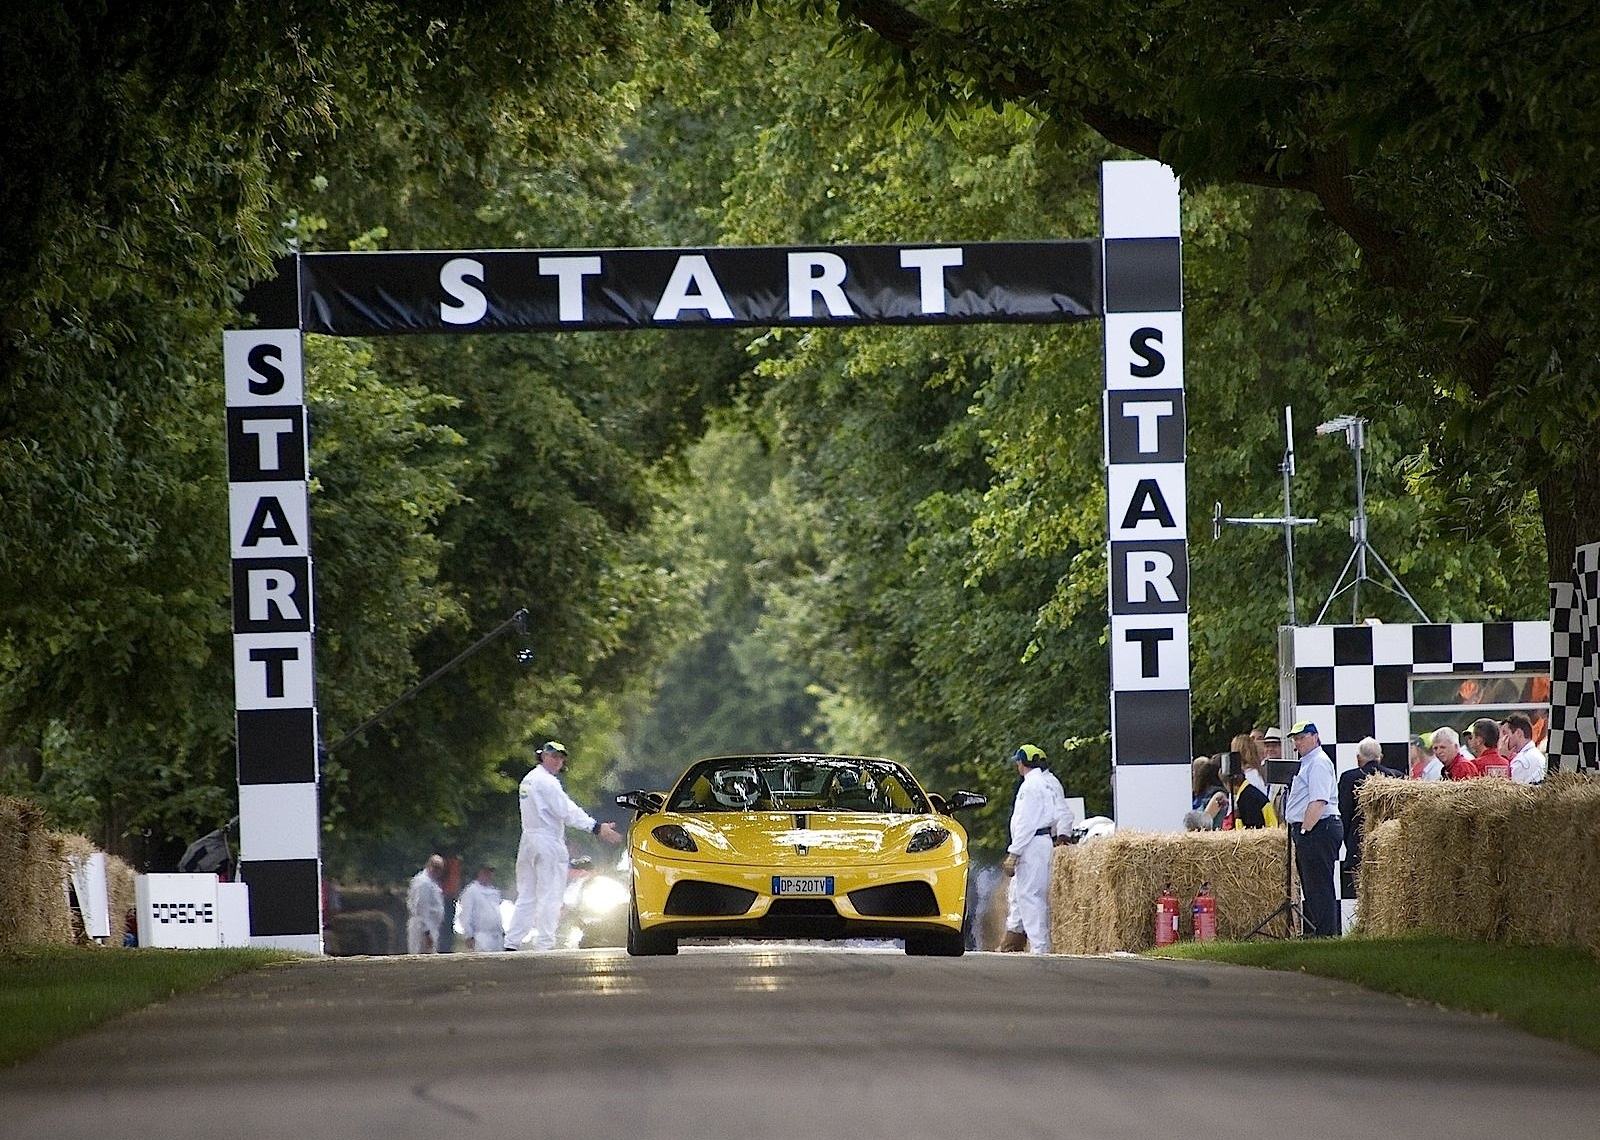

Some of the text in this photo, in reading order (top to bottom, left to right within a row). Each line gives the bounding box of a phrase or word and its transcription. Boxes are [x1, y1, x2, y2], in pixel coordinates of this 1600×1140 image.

[439, 247, 964, 325] START
[241, 343, 302, 699] START
[1120, 326, 1180, 679] START
